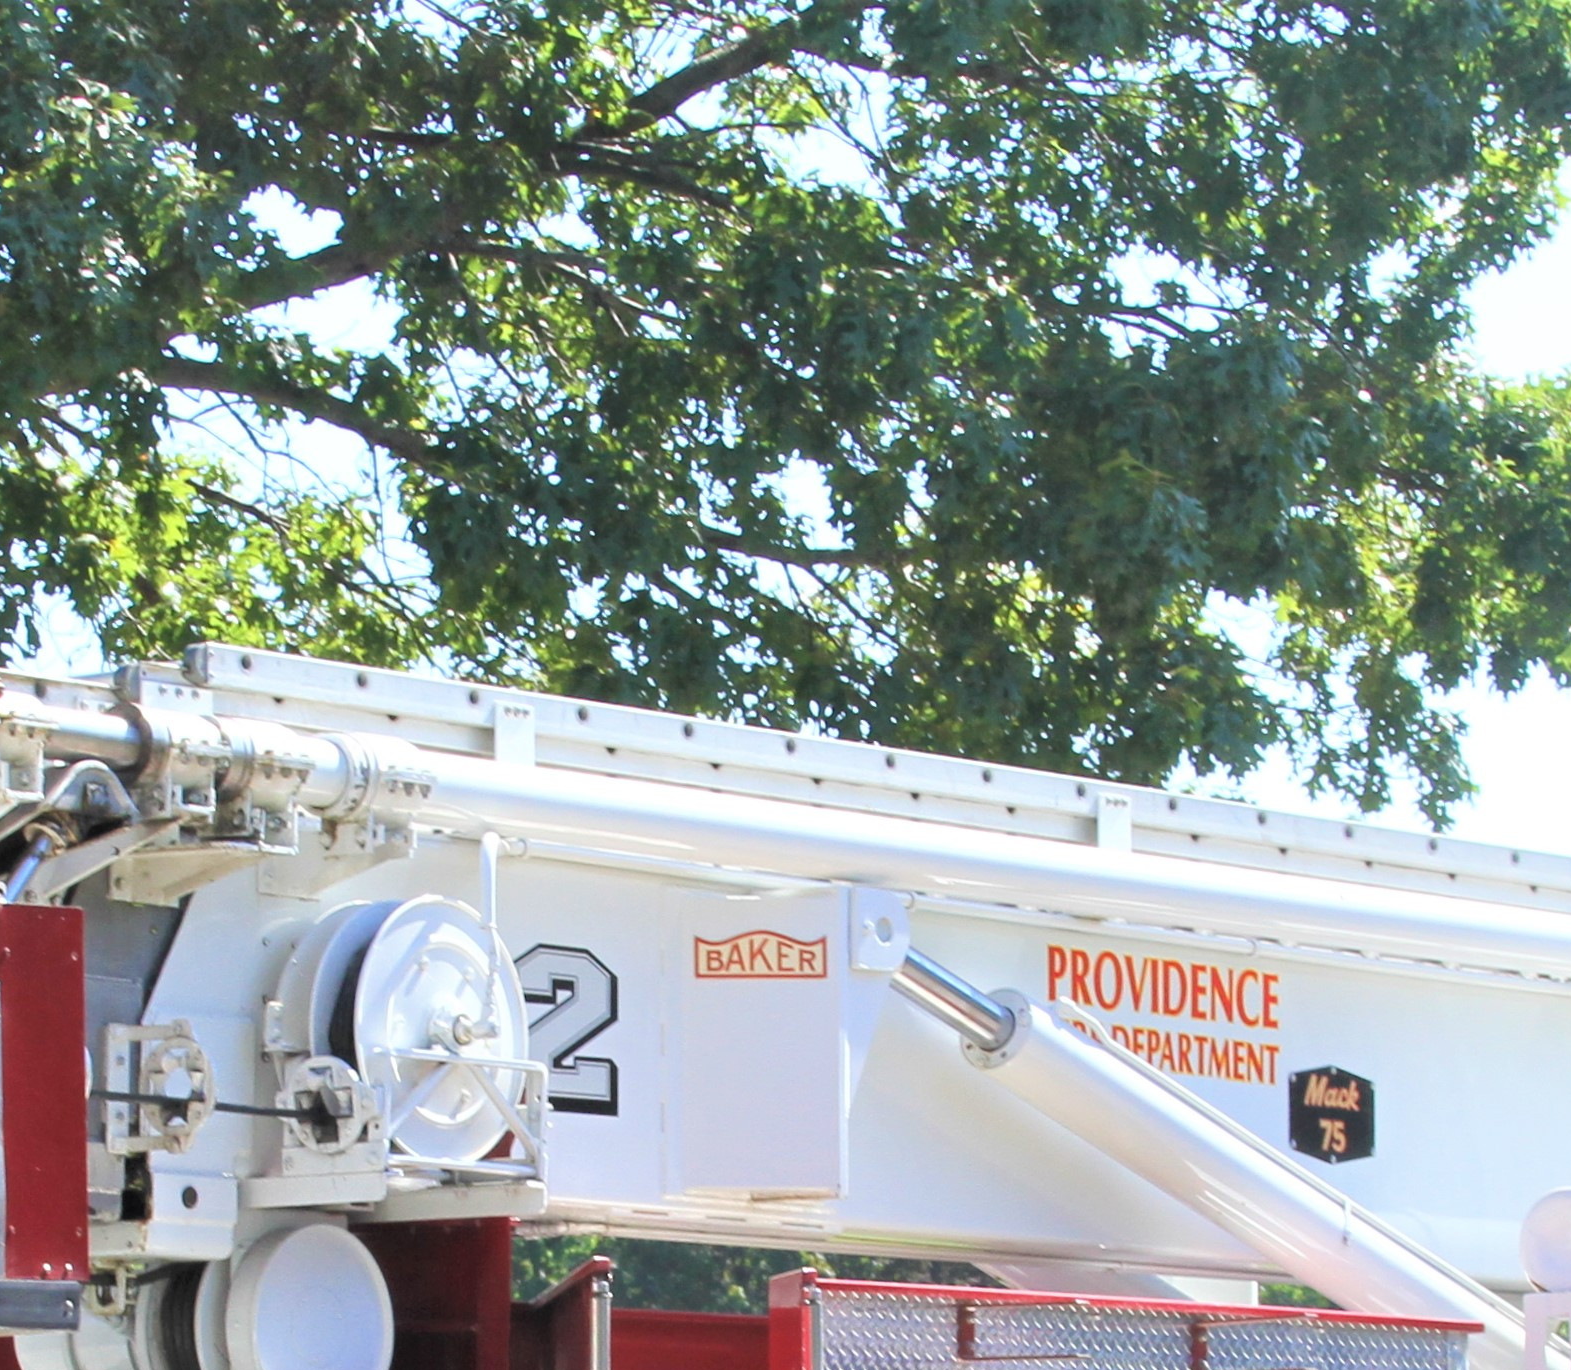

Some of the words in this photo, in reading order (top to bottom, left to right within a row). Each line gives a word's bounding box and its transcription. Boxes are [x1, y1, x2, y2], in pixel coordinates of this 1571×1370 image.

[705, 938, 818, 972] BAKER
[1047, 945, 1279, 1030] PROVIDENCE
[514, 943, 619, 1117] 2
[1112, 1024, 1279, 1085] DEPARTMENT
[1304, 1074, 1360, 1112] Mack
[1319, 1119, 1347, 1153] 75
